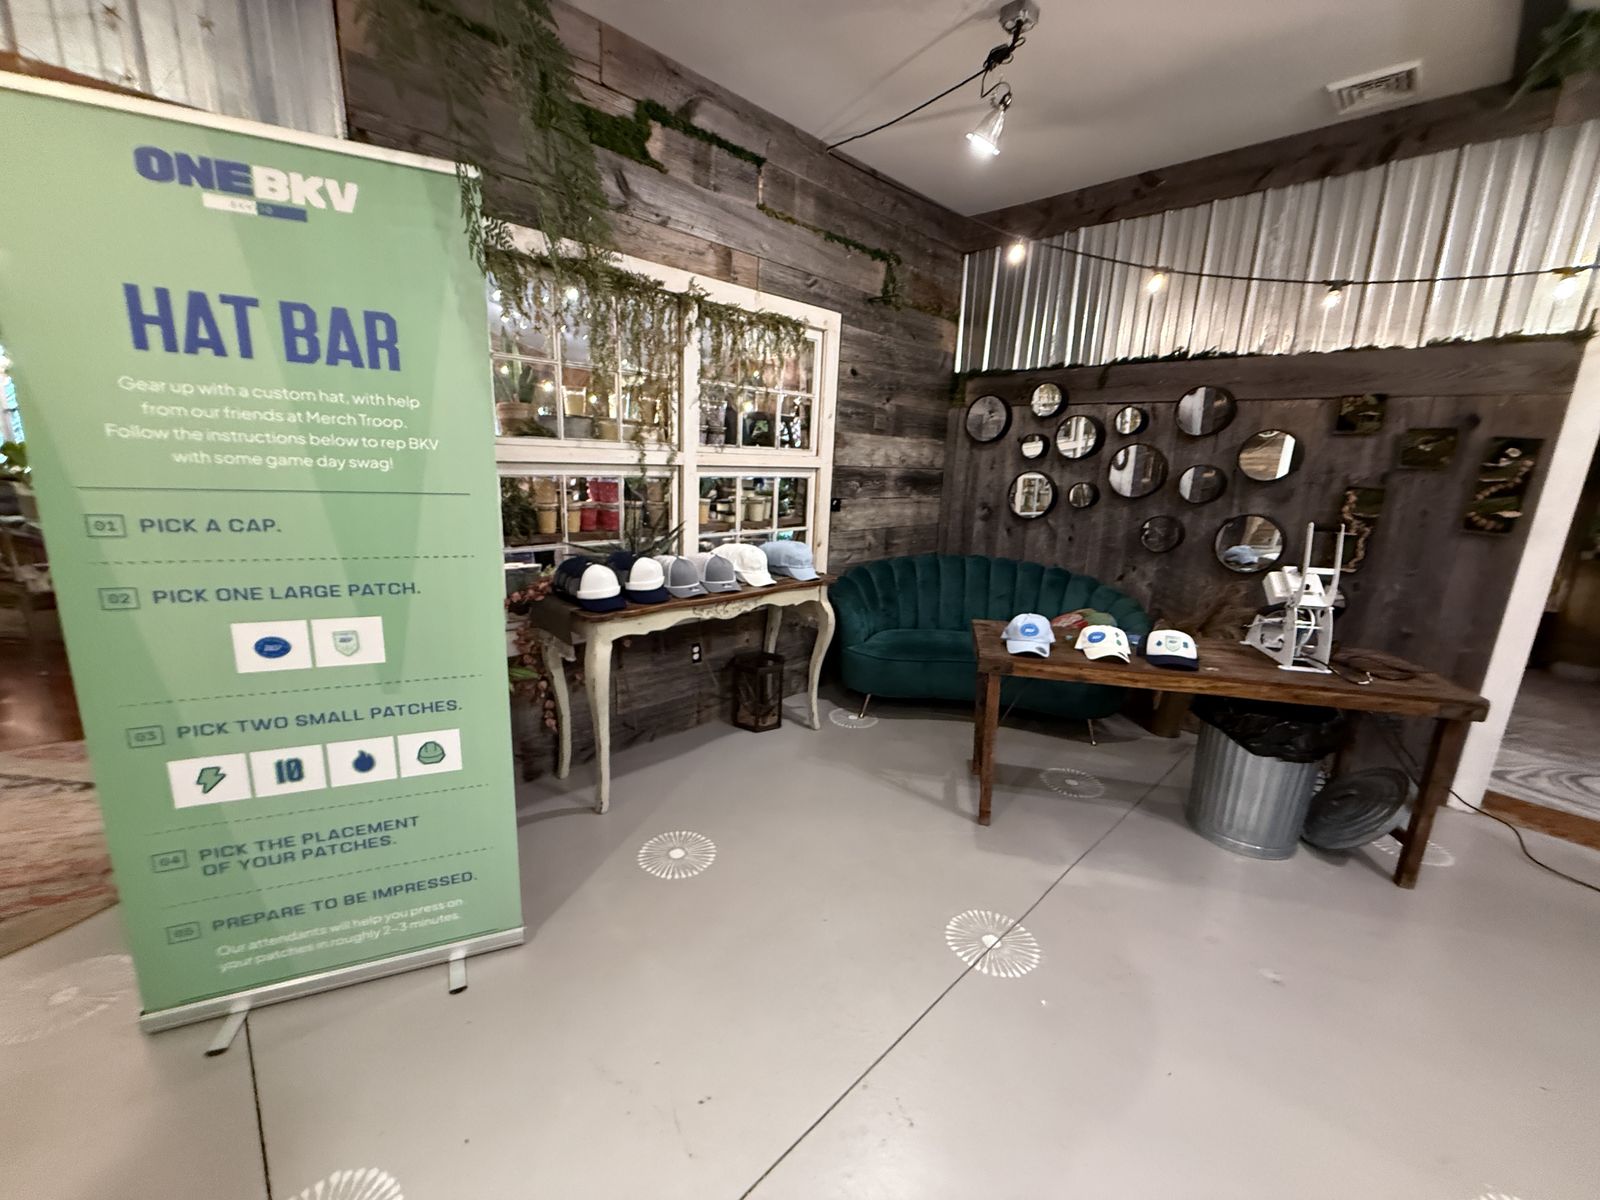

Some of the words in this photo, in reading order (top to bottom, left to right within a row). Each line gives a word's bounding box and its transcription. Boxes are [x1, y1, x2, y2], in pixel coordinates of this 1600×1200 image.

[133, 145, 358, 213] ONEBKV
[122, 282, 259, 359] HAT
[279, 300, 401, 371] BAR
[117, 375, 166, 392] Gear
[169, 383, 194, 396] up
[197, 382, 236, 396] with
[238, 387, 249, 398] a
[252, 387, 316, 401] custom
[351, 393, 385, 406] with
[387, 394, 420, 410] help
[141, 401, 188, 417] from
[190, 407, 220, 418] our
[223, 406, 284, 422] friends
[287, 412, 303, 423] at
[306, 411, 357, 426] Merch
[358, 413, 408, 430] Troop.
[104, 422, 169, 439] Follow
[172, 427, 203, 440] the
[206, 429, 306, 445] instructions
[309, 433, 358, 447] below
[362, 437, 378, 448] to
[381, 438, 406, 450] rep
[408, 437, 438, 450] BKV
[171, 451, 212, 464] with
[214, 454, 263, 465] some
[265, 455, 313, 469] game
[317, 455, 346, 471] day
[349, 456, 394, 472] swag!
[139, 518, 198, 533] PICK
[206, 518, 222, 532] A
[228, 518, 282, 533] CAP.
[152, 588, 208, 604] PICK
[215, 587, 263, 602] ONE
[270, 584, 342, 600] LARGE
[347, 582, 421, 597] PATCH.
[176, 722, 229, 739] PICK
[236, 716, 289, 733] TWO
[295, 709, 365, 727] SMALL
[370, 699, 463, 720] PATCHES.
[275, 758, 305, 784] 10
[198, 843, 249, 861] PICK
[254, 835, 296, 852] THE
[301, 815, 420, 845] PLACEMENT
[202, 861, 230, 877] OF
[237, 851, 297, 870] YOUR
[301, 835, 397, 860] PATCHES.
[212, 903, 306, 931] PREPARE
[311, 897, 337, 911] TO
[343, 891, 368, 907] BE
[372, 871, 478, 900] IMPRESSED.
[216, 944, 246, 957] Our
[247, 926, 330, 951] attendants
[330, 920, 351, 933] will
[352, 914, 382, 928] help
[383, 909, 409, 924] you
[410, 903, 446, 917] press
[447, 898, 464, 909] on
[218, 957, 253, 974] your
[254, 944, 315, 966] patches
[315, 940, 329, 950] in
[329, 929, 381, 947] roughly
